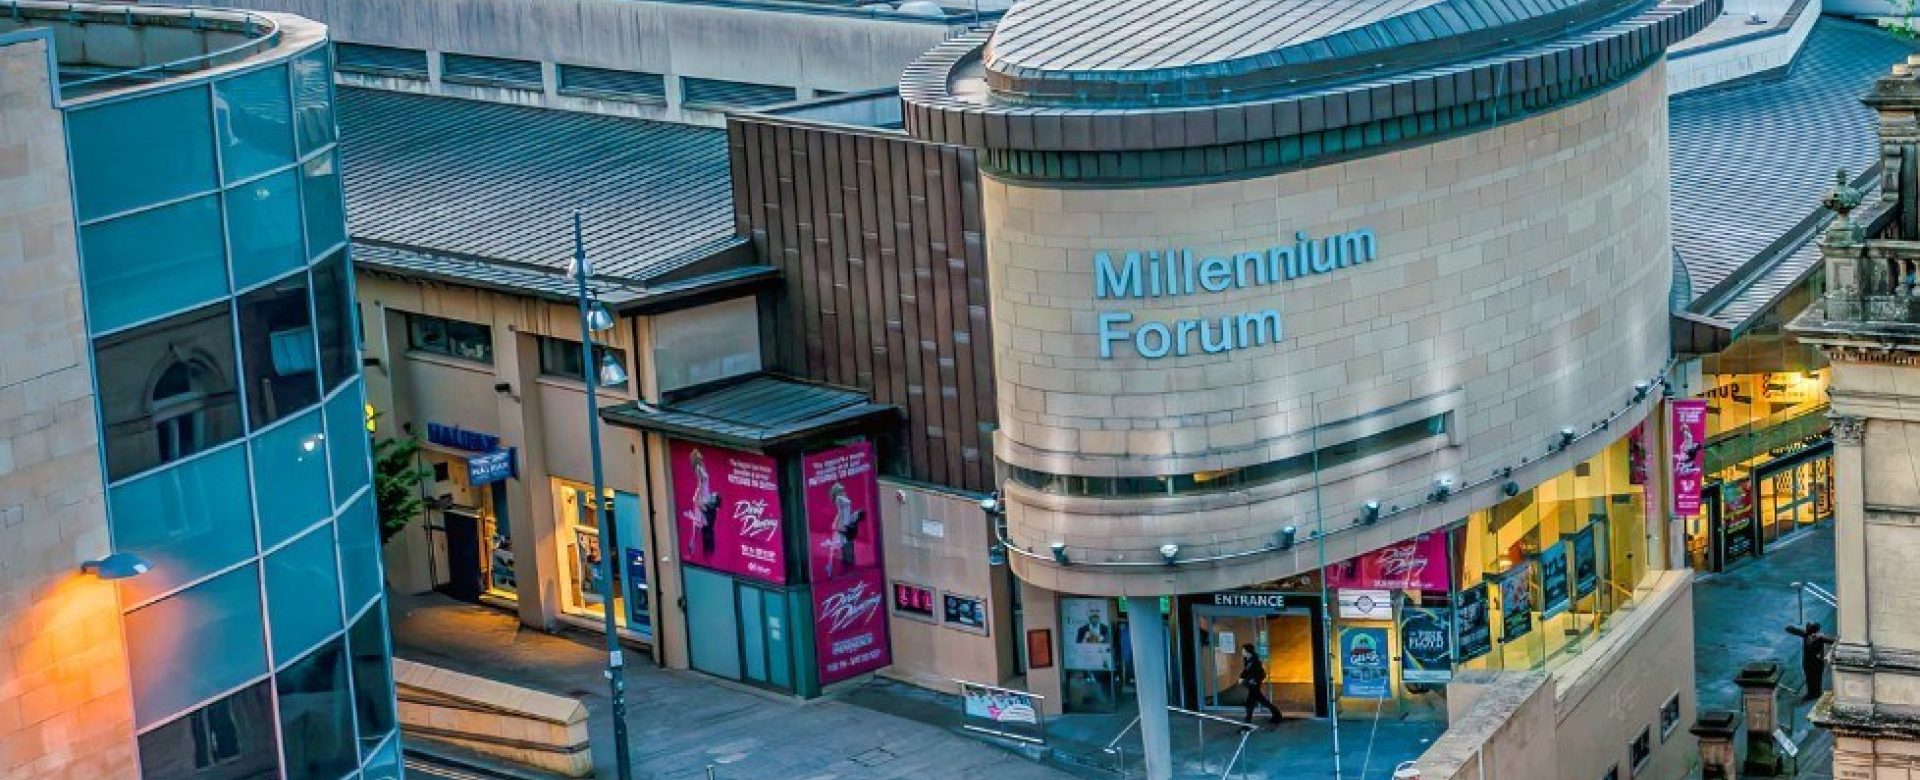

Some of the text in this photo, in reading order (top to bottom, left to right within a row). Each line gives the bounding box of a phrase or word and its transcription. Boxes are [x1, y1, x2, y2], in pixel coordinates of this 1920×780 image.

[1094, 226, 1377, 298] Millennium
[1098, 308, 1283, 358] Forum
[818, 581, 869, 622] Dirty
[828, 594, 882, 634] Dancing
[1214, 593, 1285, 607] ENTRANCE
